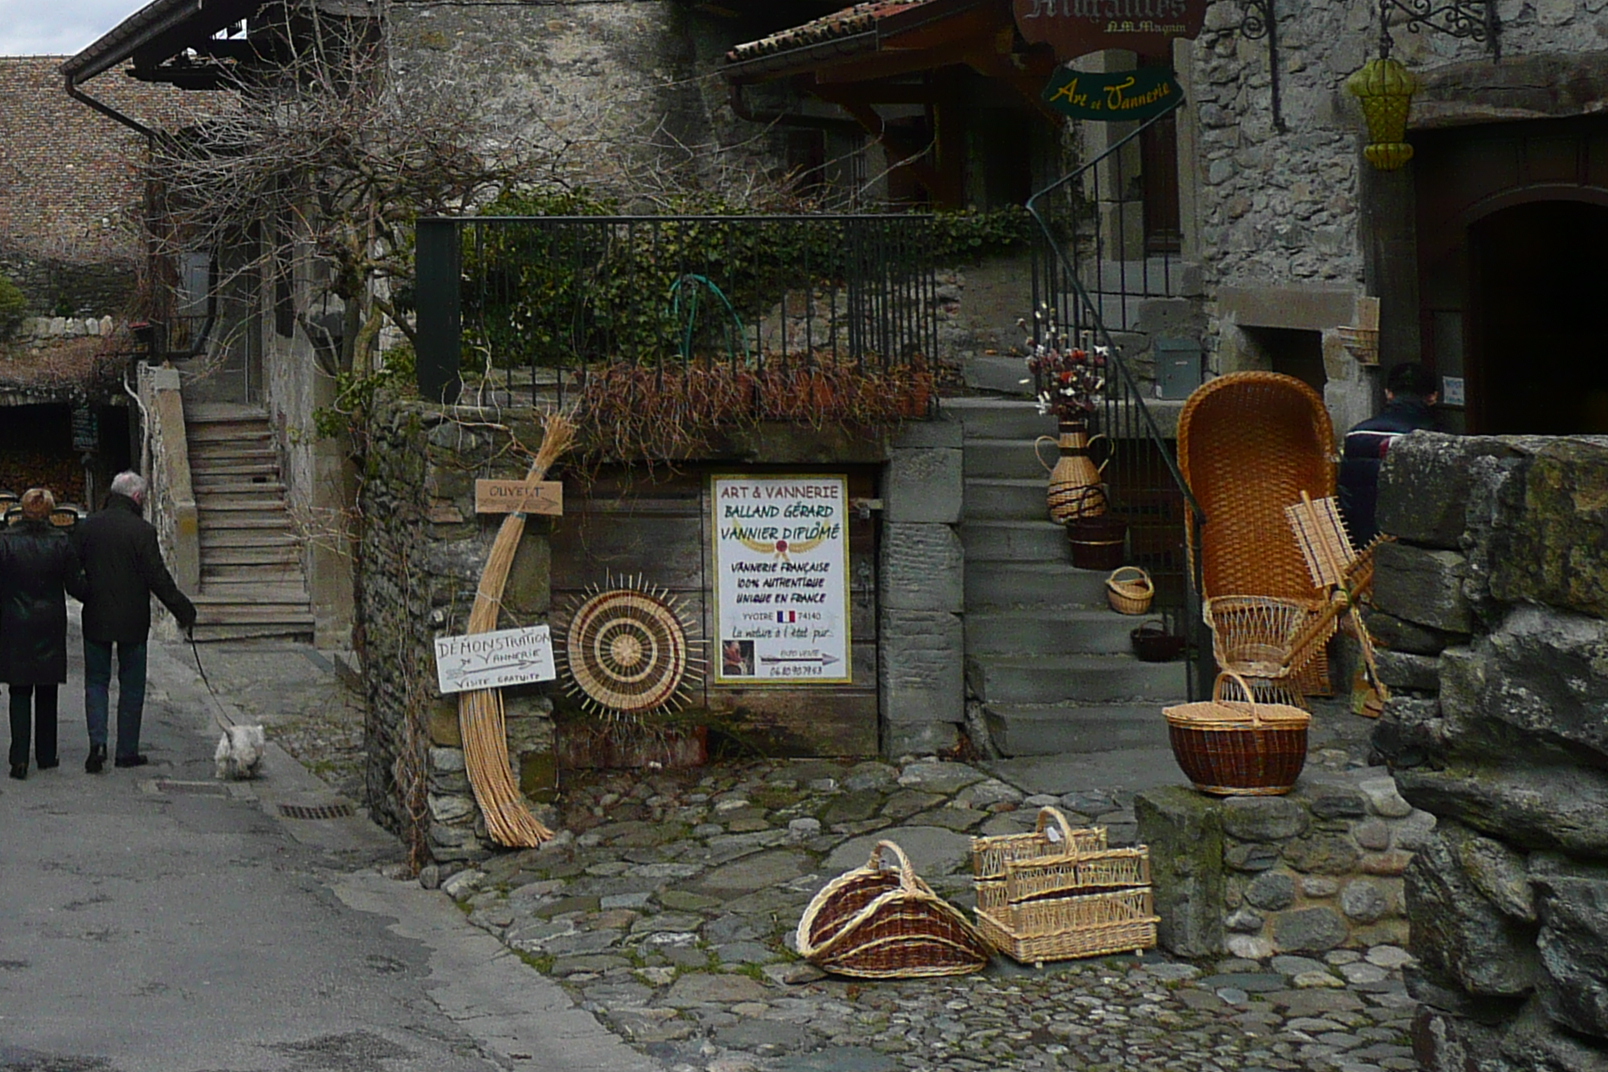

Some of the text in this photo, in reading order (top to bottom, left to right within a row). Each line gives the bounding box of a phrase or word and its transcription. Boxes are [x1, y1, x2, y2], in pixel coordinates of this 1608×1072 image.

[1049, 76, 1171, 110] Art et Vannerie
[720, 485, 839, 499] ART & VANNERIE
[724, 500, 834, 518] BALLAND GÉRARD
[721, 526, 779, 540] VANNIER
[780, 562, 830, 575] FRANÇAISE
[737, 577, 825, 589] 100% AUTHENTIQUE
[736, 593, 827, 604] UNIQUE EN FRANCE
[742, 611, 822, 621] YVOIRE 74140
[745, 627, 772, 639] nature
